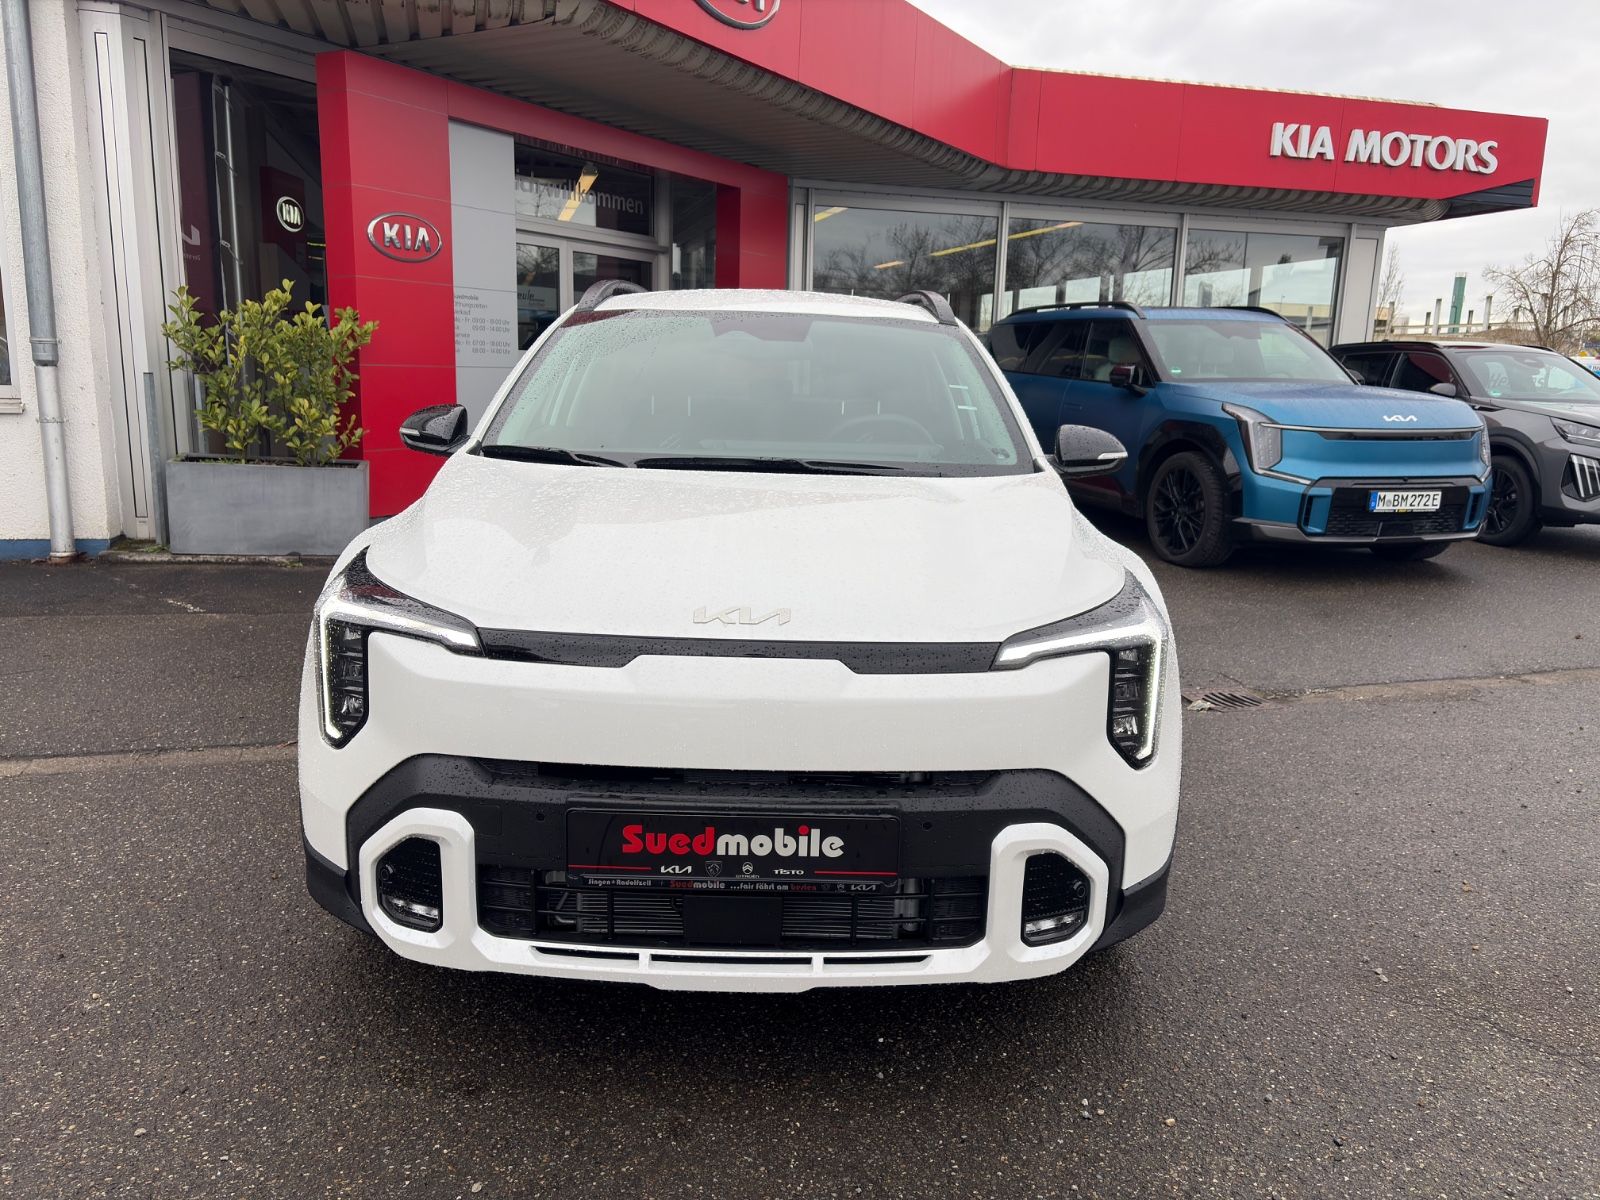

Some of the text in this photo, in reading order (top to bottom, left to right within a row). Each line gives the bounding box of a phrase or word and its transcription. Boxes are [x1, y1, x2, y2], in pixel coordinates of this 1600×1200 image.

[1270, 122, 1498, 174] KIA MOTORS
[545, 178, 644, 215] willkommen
[382, 221, 432, 253] KIA
[622, 825, 845, 858] Suedmobile
[588, 879, 611, 887] Singen
[670, 880, 725, 889] Suedmobile
[755, 883, 775, 891] fährt
[660, 865, 692, 874] KIA
